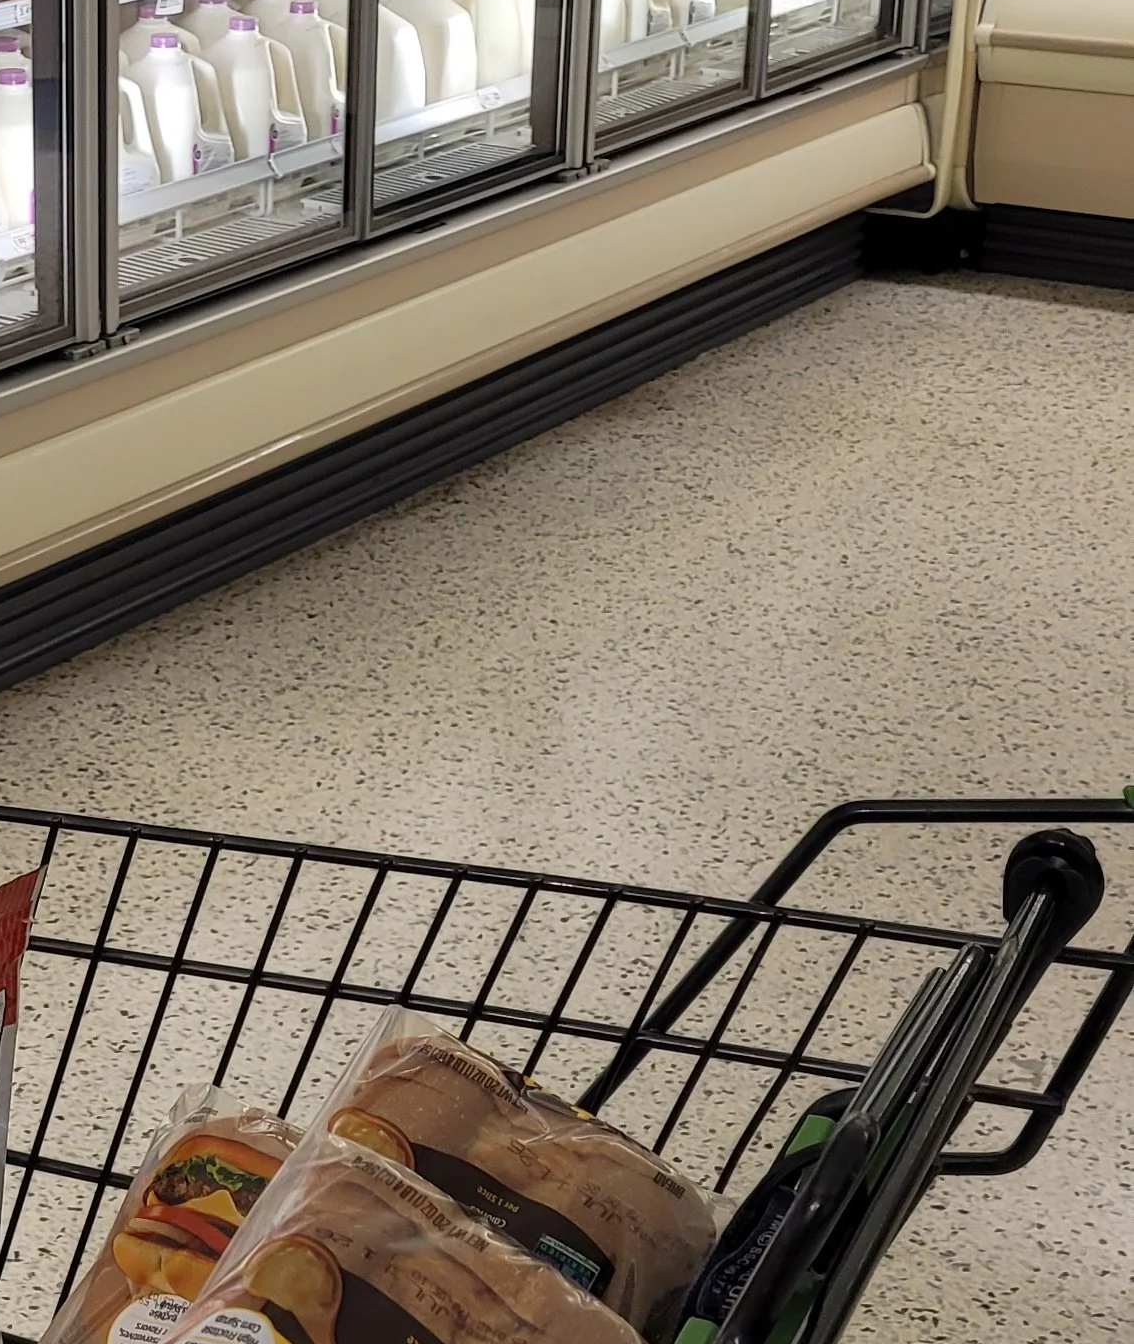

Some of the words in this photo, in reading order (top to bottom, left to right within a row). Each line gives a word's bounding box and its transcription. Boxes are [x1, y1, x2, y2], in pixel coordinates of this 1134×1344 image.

[653, 1171, 686, 1201] BREAD
[431, 1212, 452, 1233] 20
[467, 1231, 490, 1253] NET
[201, 1324, 238, 1341] Fructose
